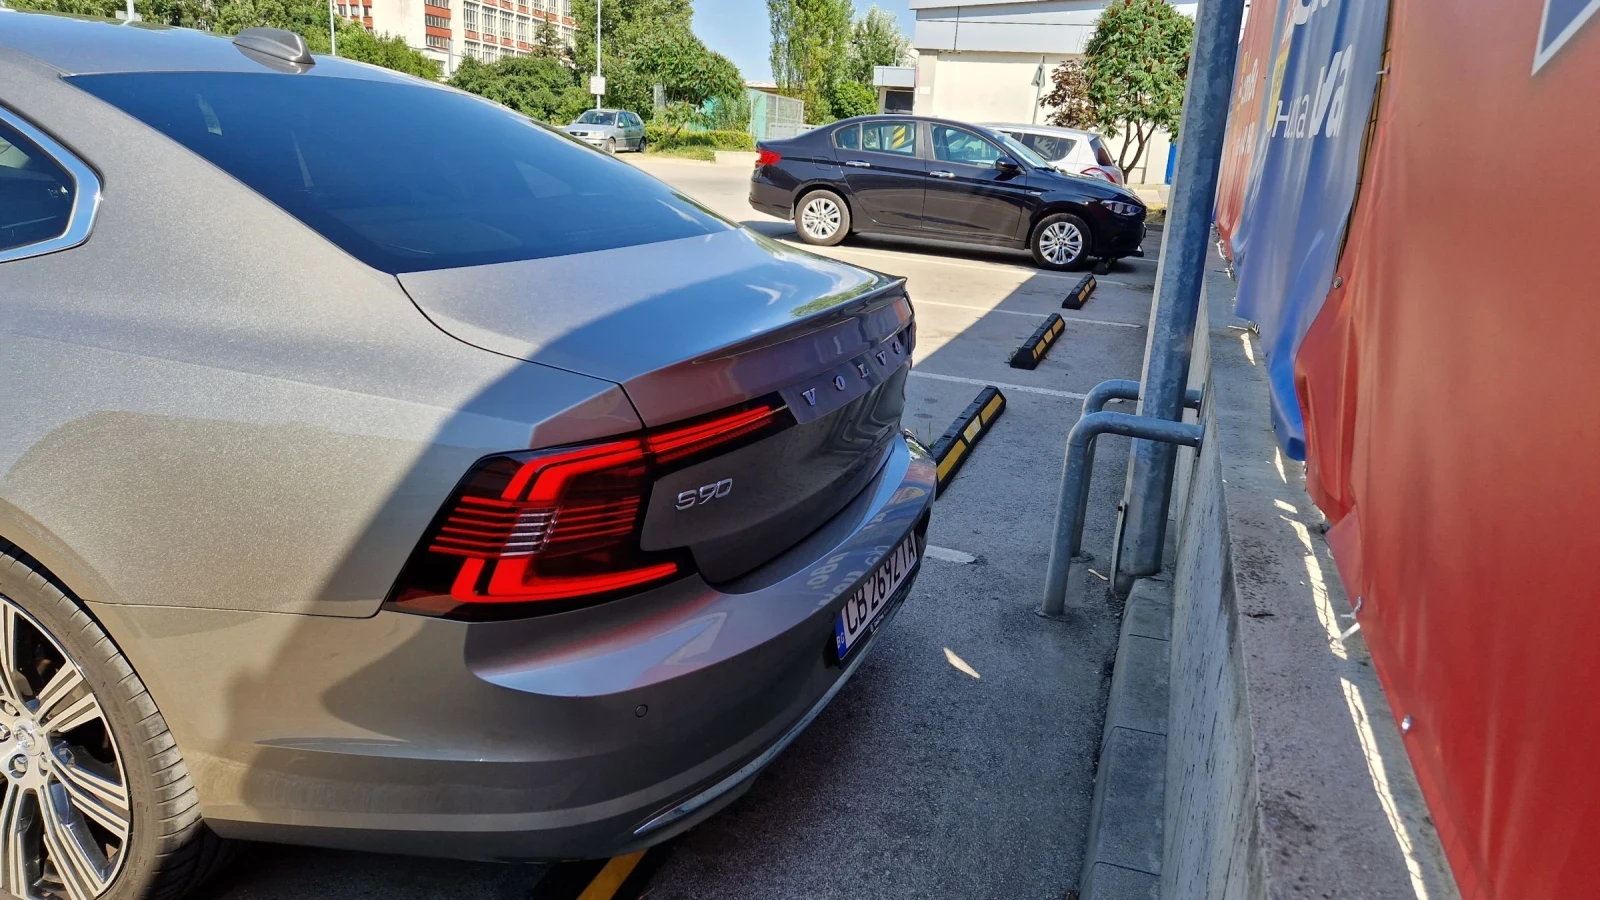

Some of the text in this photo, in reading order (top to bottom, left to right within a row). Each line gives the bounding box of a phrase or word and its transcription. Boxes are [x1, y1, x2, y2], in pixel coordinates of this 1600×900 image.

[801, 341, 901, 406] VOLVO
[675, 478, 733, 511] S90
[845, 587, 868, 635] CB
[868, 550, 900, 612] 2692
[836, 631, 845, 650] BG
